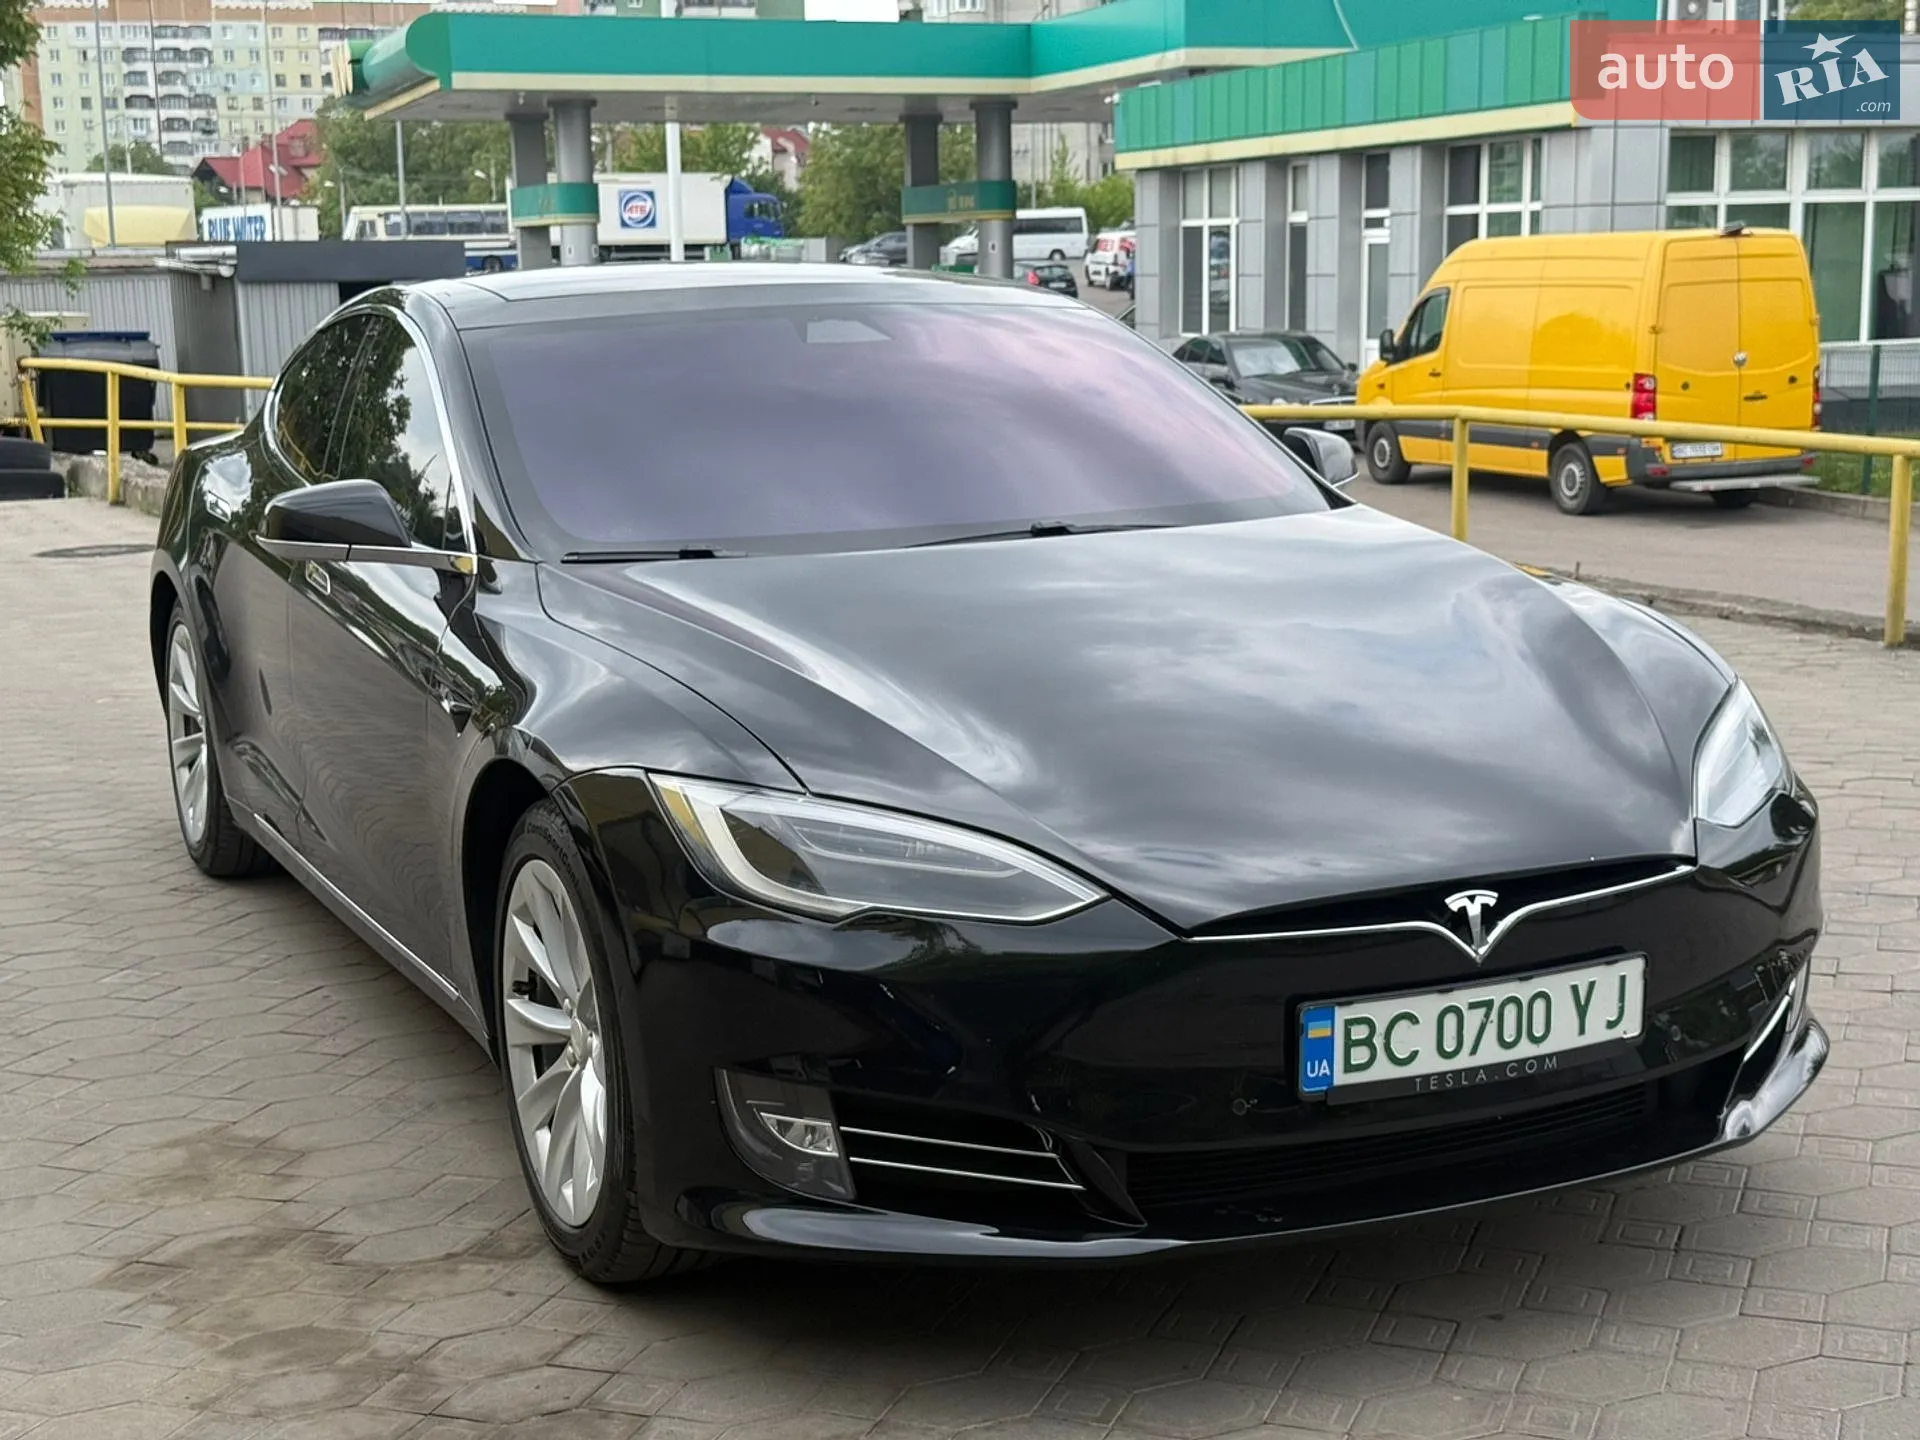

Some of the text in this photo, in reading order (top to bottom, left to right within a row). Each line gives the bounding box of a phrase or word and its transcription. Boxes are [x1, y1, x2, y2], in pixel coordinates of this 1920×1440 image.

[1343, 974, 1627, 1074] BC 0700 YJ
[1307, 1059, 1330, 1078] UA
[1415, 1055, 1558, 1091] TESLA.COM
